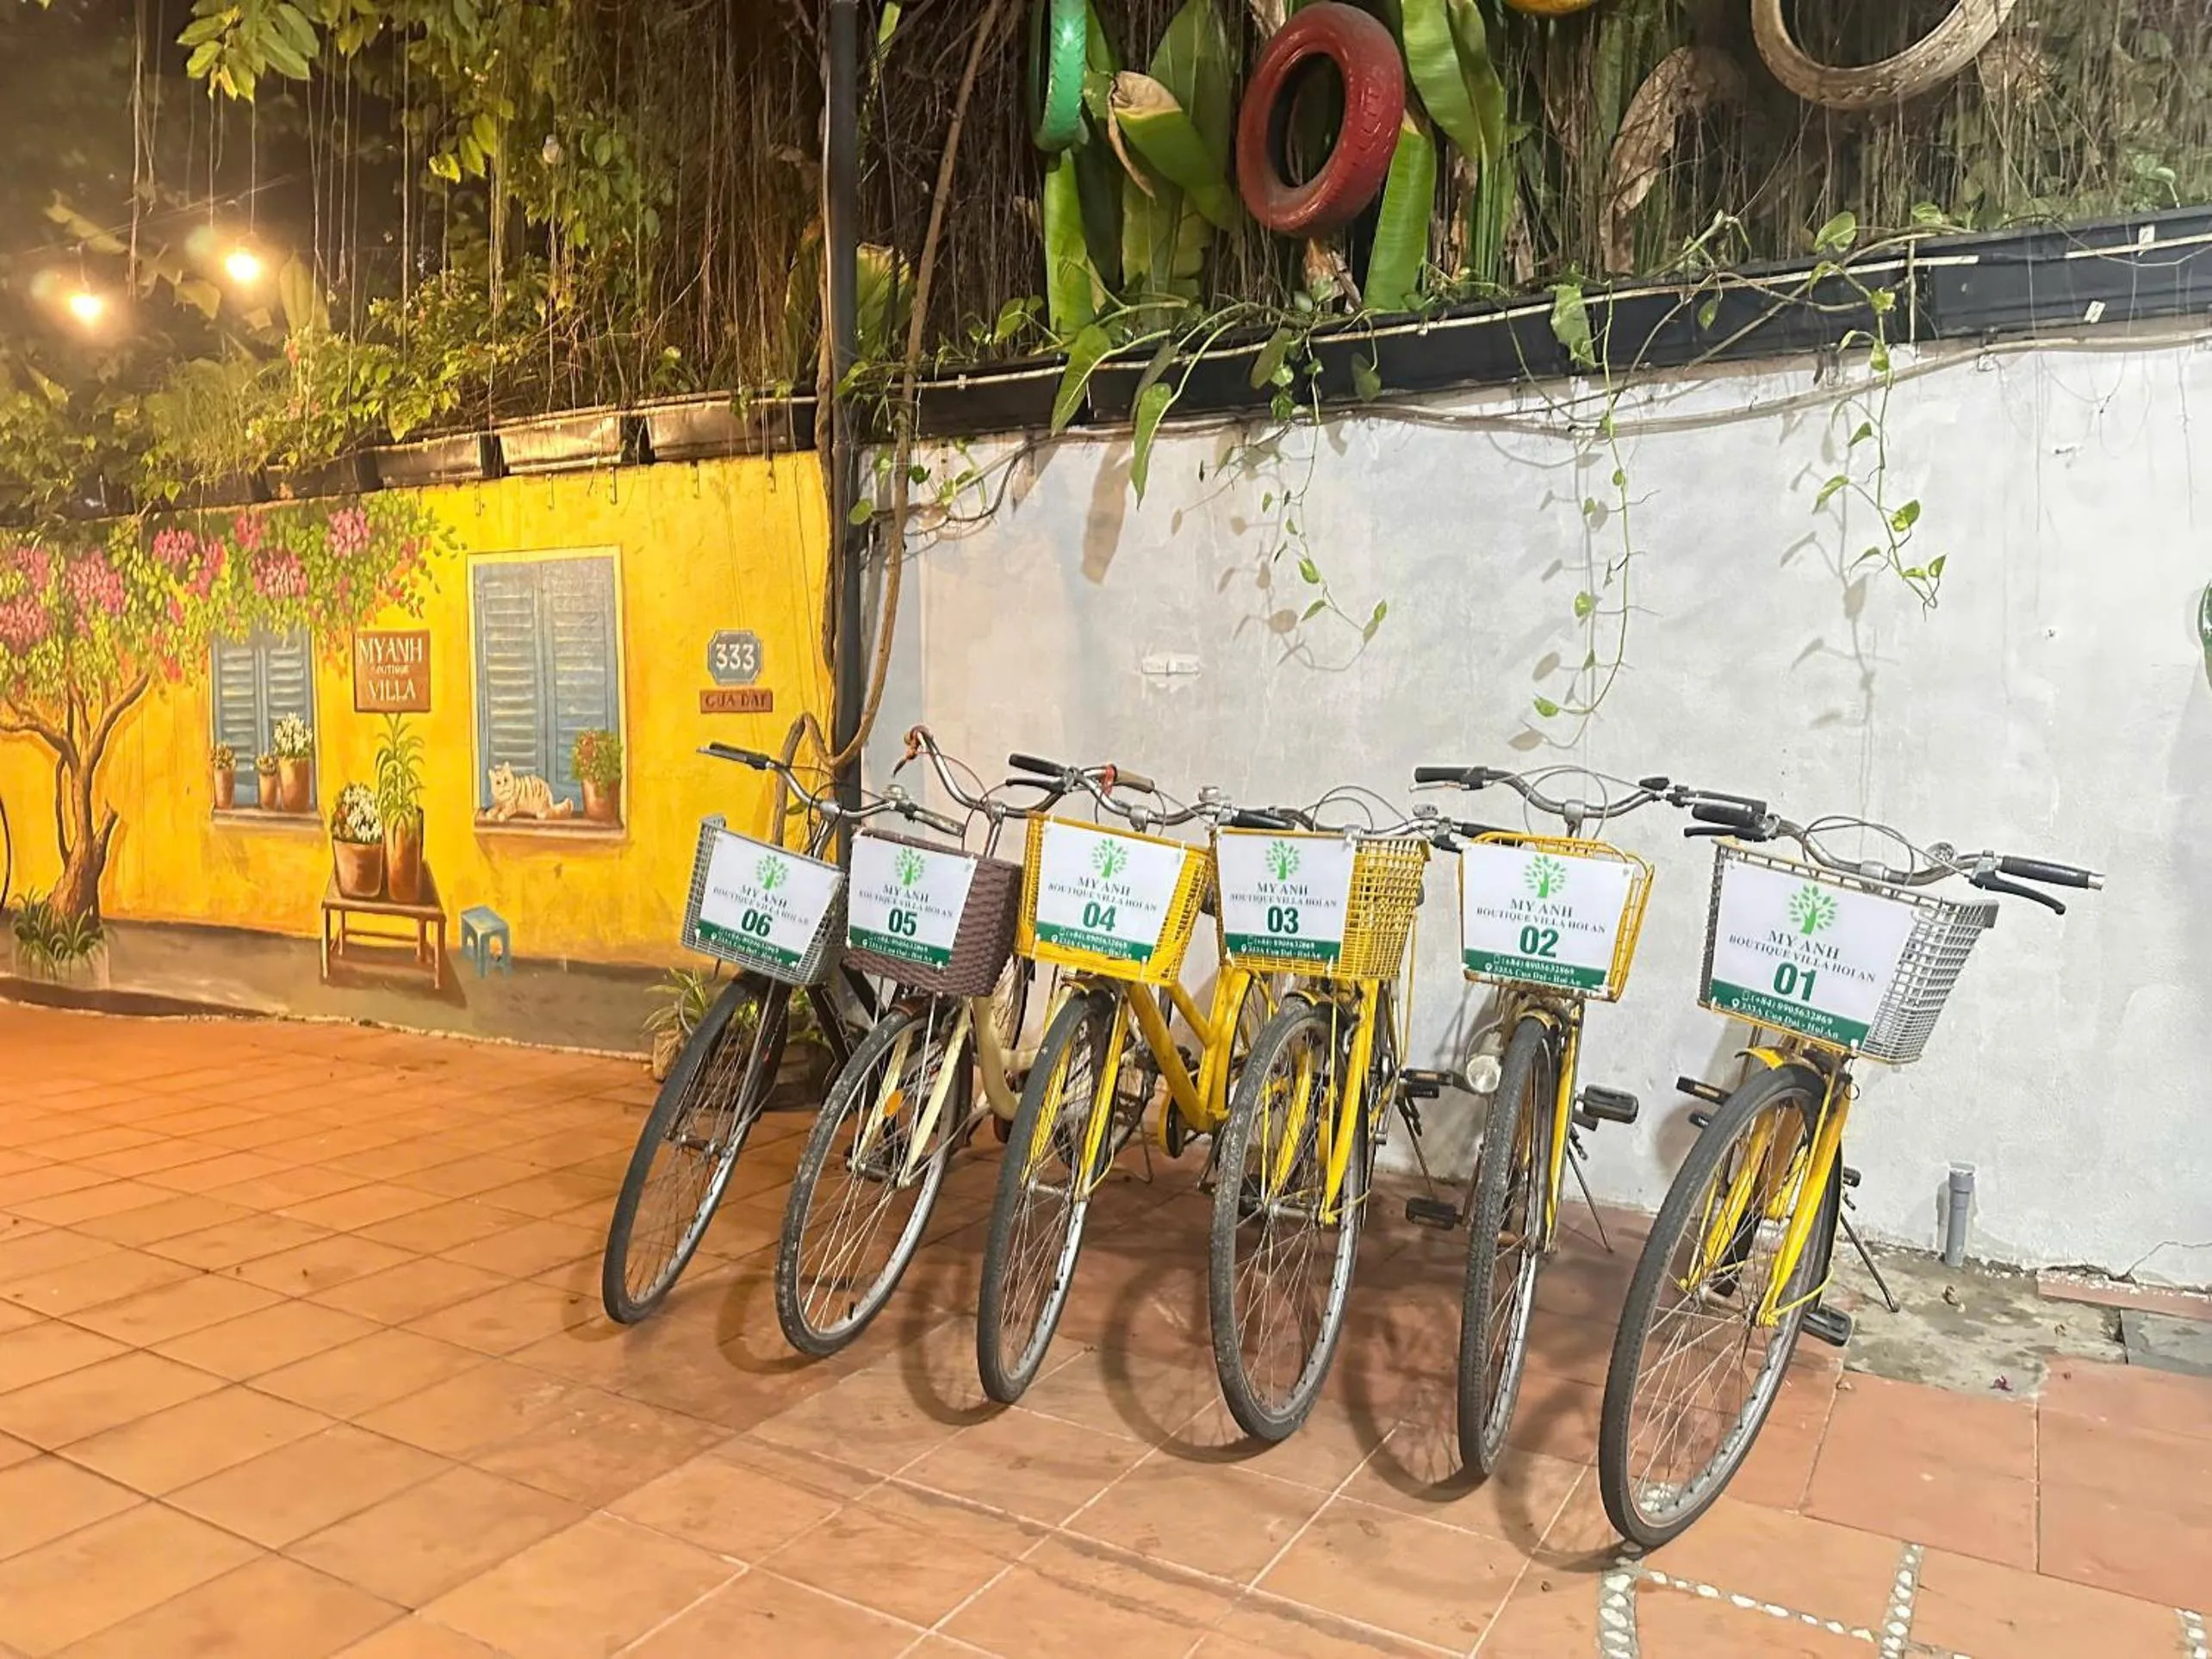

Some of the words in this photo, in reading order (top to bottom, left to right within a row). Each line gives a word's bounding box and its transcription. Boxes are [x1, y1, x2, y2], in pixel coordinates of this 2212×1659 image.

[716, 643, 755, 670] 333
[369, 679, 416, 701] VILLA
[739, 885, 759, 898] MY
[761, 893, 786, 908] ANH
[883, 885, 901, 896] MY
[904, 889, 929, 903] ANH
[1078, 877, 1098, 889] MY
[1102, 882, 1130, 896] ANH
[1230, 893, 1273, 904] BOUTIQUE
[1258, 882, 1277, 893] MY
[1281, 884, 1308, 896] ANH
[889, 907, 917, 936] 05
[1083, 901, 1117, 931] 04
[1267, 905, 1299, 934] 03
[1476, 907, 1532, 922] BOUTIQUE
[1534, 916, 1565, 929] VILLA
[1569, 921, 1588, 930] HOI
[1590, 924, 1605, 933] AN
[1510, 898, 1535, 911] MY
[1538, 904, 1573, 918] ANH
[741, 909, 773, 937] 06
[1519, 925, 1559, 958] 02
[1768, 929, 1798, 947] MY
[1799, 940, 1839, 959] ANH
[1729, 934, 1791, 958] BOUTIQUE
[1793, 952, 1828, 969] VILLA
[1832, 962, 1855, 977] HOI
[1857, 972, 1875, 982] AN
[1773, 961, 1817, 1001] 01
